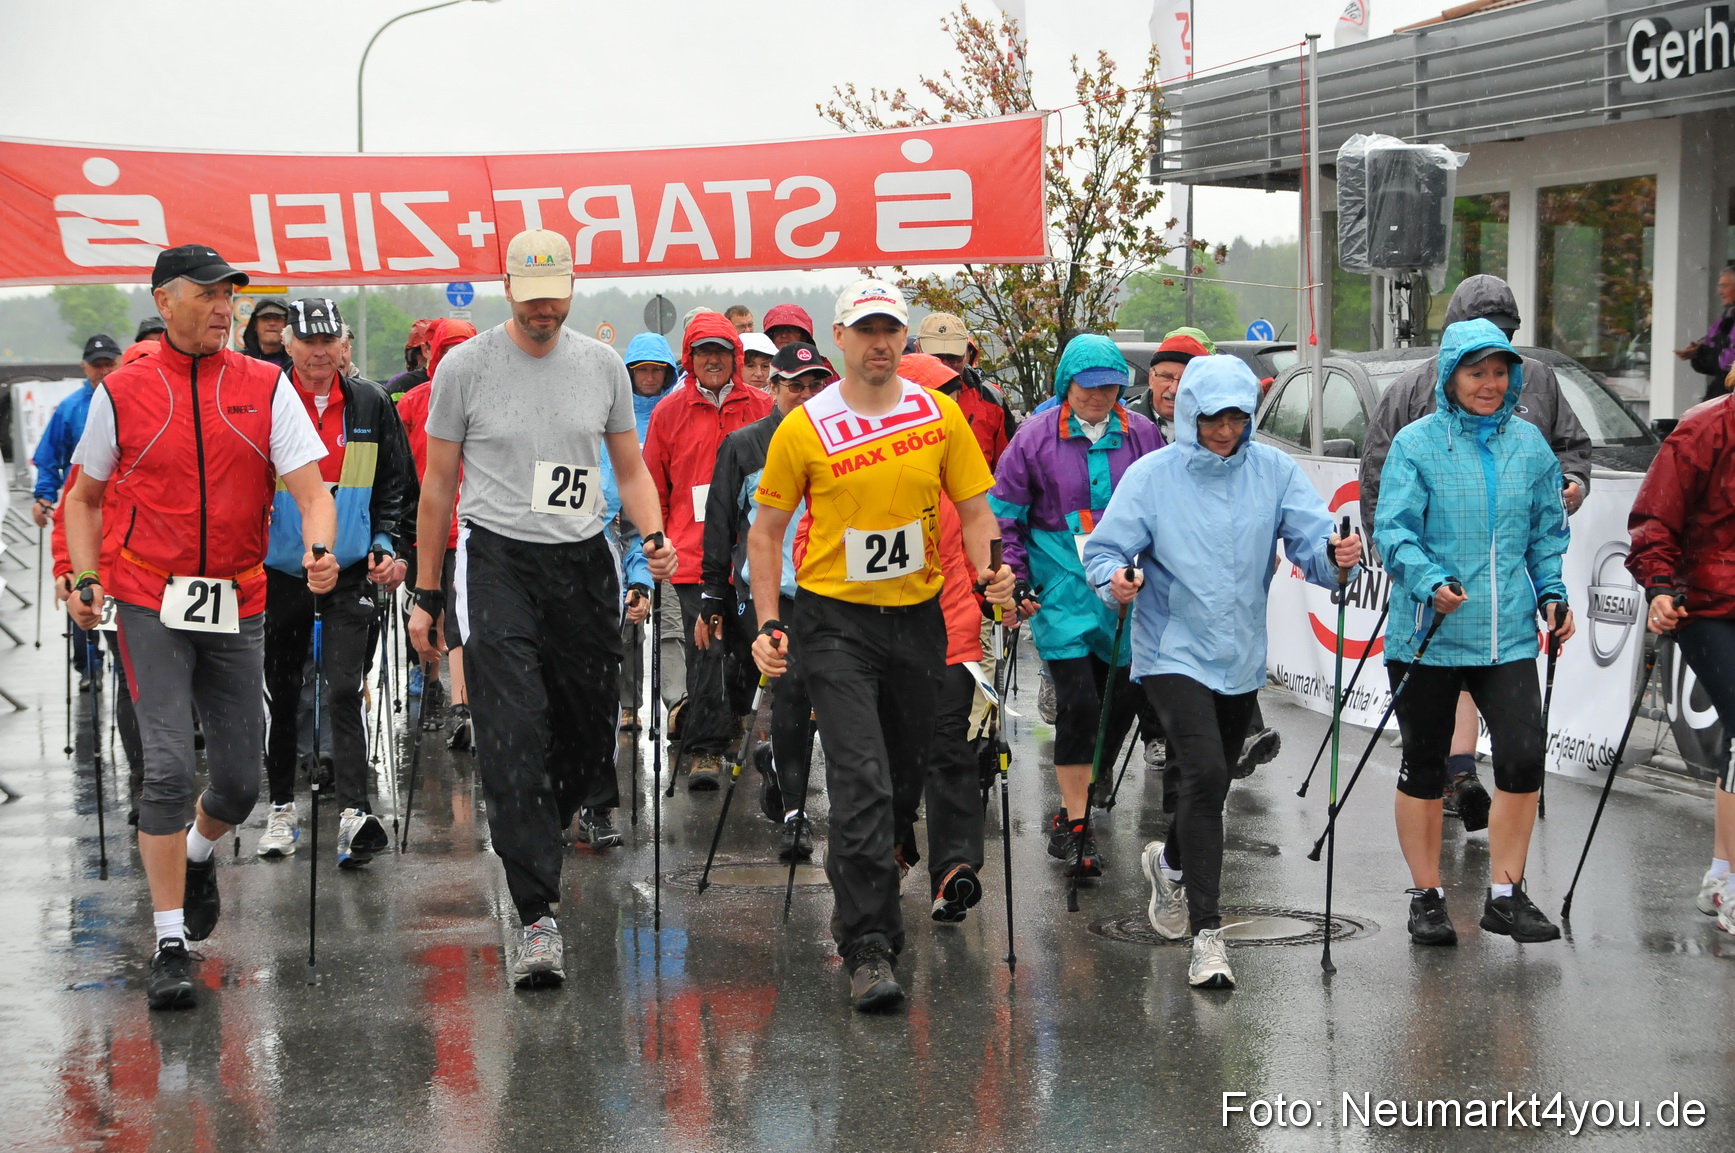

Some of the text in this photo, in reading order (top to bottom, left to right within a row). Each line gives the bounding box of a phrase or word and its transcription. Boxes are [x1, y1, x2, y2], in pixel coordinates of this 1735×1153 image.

[1626, 7, 1735, 84] Gerh
[526, 255, 554, 264] AIDA
[600, 329, 611, 339] 60
[831, 427, 946, 478] MAX BÖGL
[548, 465, 588, 509] 25
[865, 530, 909, 574] 24
[101, 596, 118, 625] 3
[184, 580, 221, 624] 21
[1593, 593, 1635, 616] NISSAN
